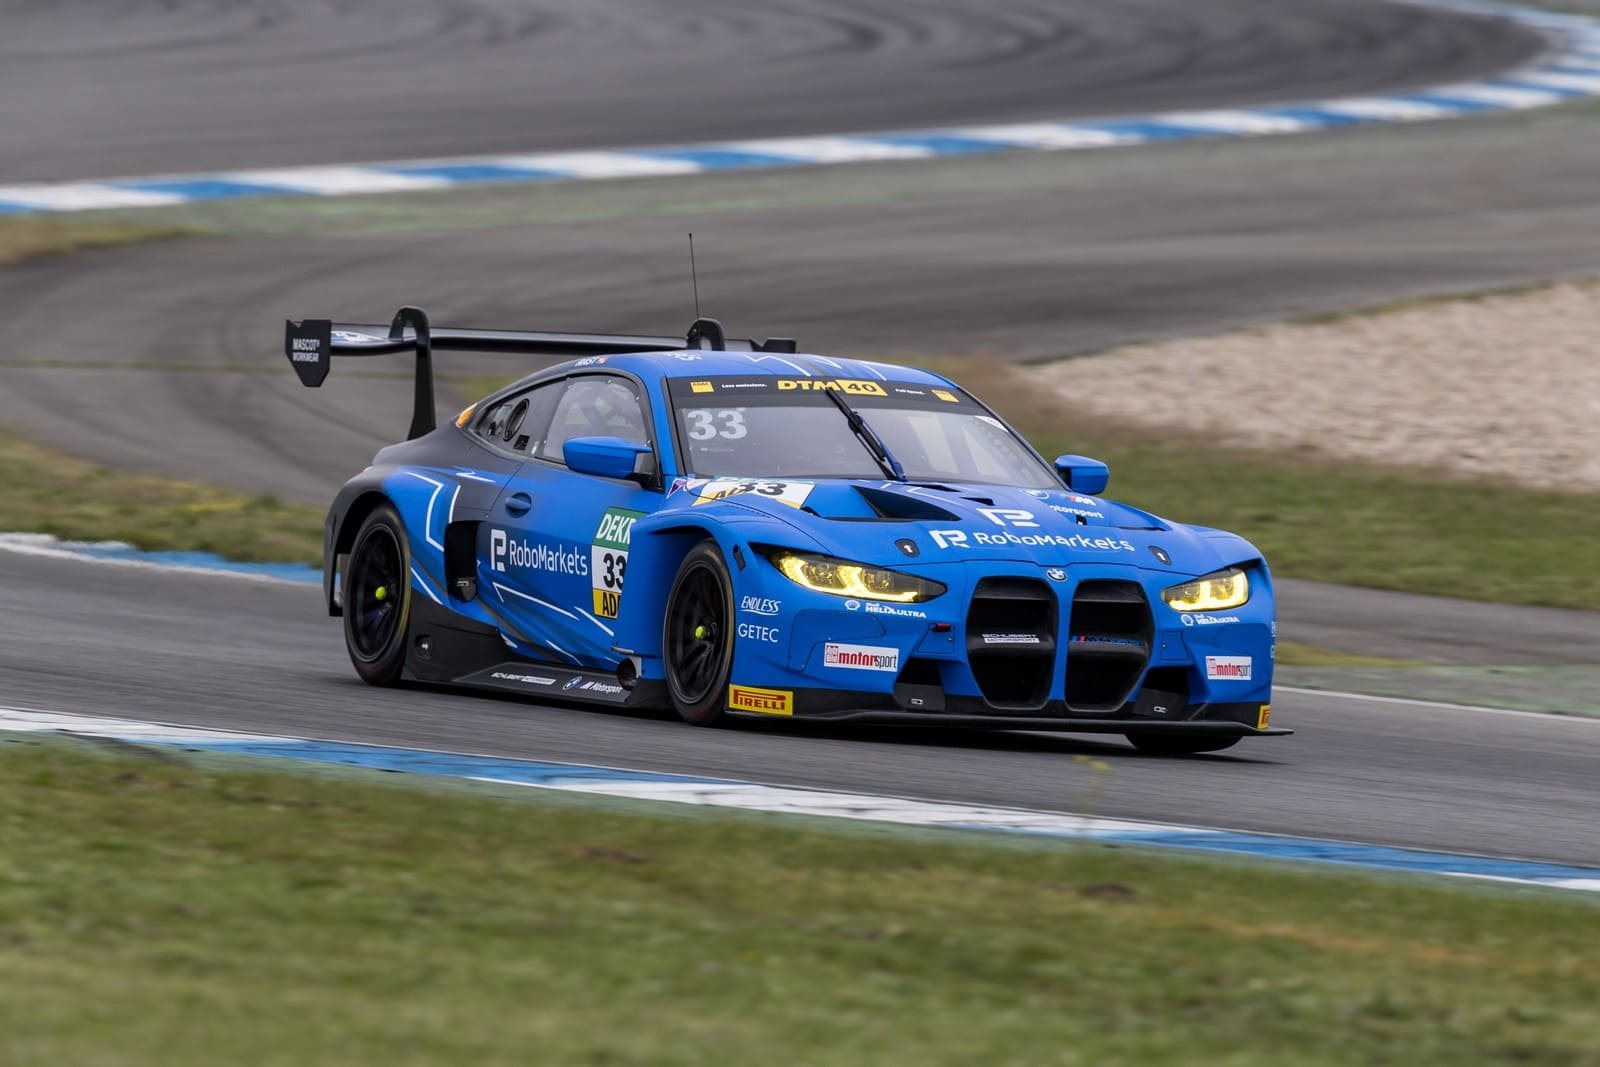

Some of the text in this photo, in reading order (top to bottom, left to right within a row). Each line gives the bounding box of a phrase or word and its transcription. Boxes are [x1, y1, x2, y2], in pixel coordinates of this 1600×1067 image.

[777, 380, 877, 392] DTM 40
[687, 409, 748, 440] 33
[738, 482, 787, 496] 33
[596, 513, 637, 545] DEKR
[973, 531, 1136, 552] RoboMarkets
[509, 538, 588, 576] RoboMarkets
[603, 552, 627, 590] 33
[602, 591, 621, 616] AD
[741, 595, 782, 614] ENDLESS
[737, 623, 780, 643] GETEC
[838, 651, 897, 669] motorsport
[733, 688, 787, 711] PIRELLI
